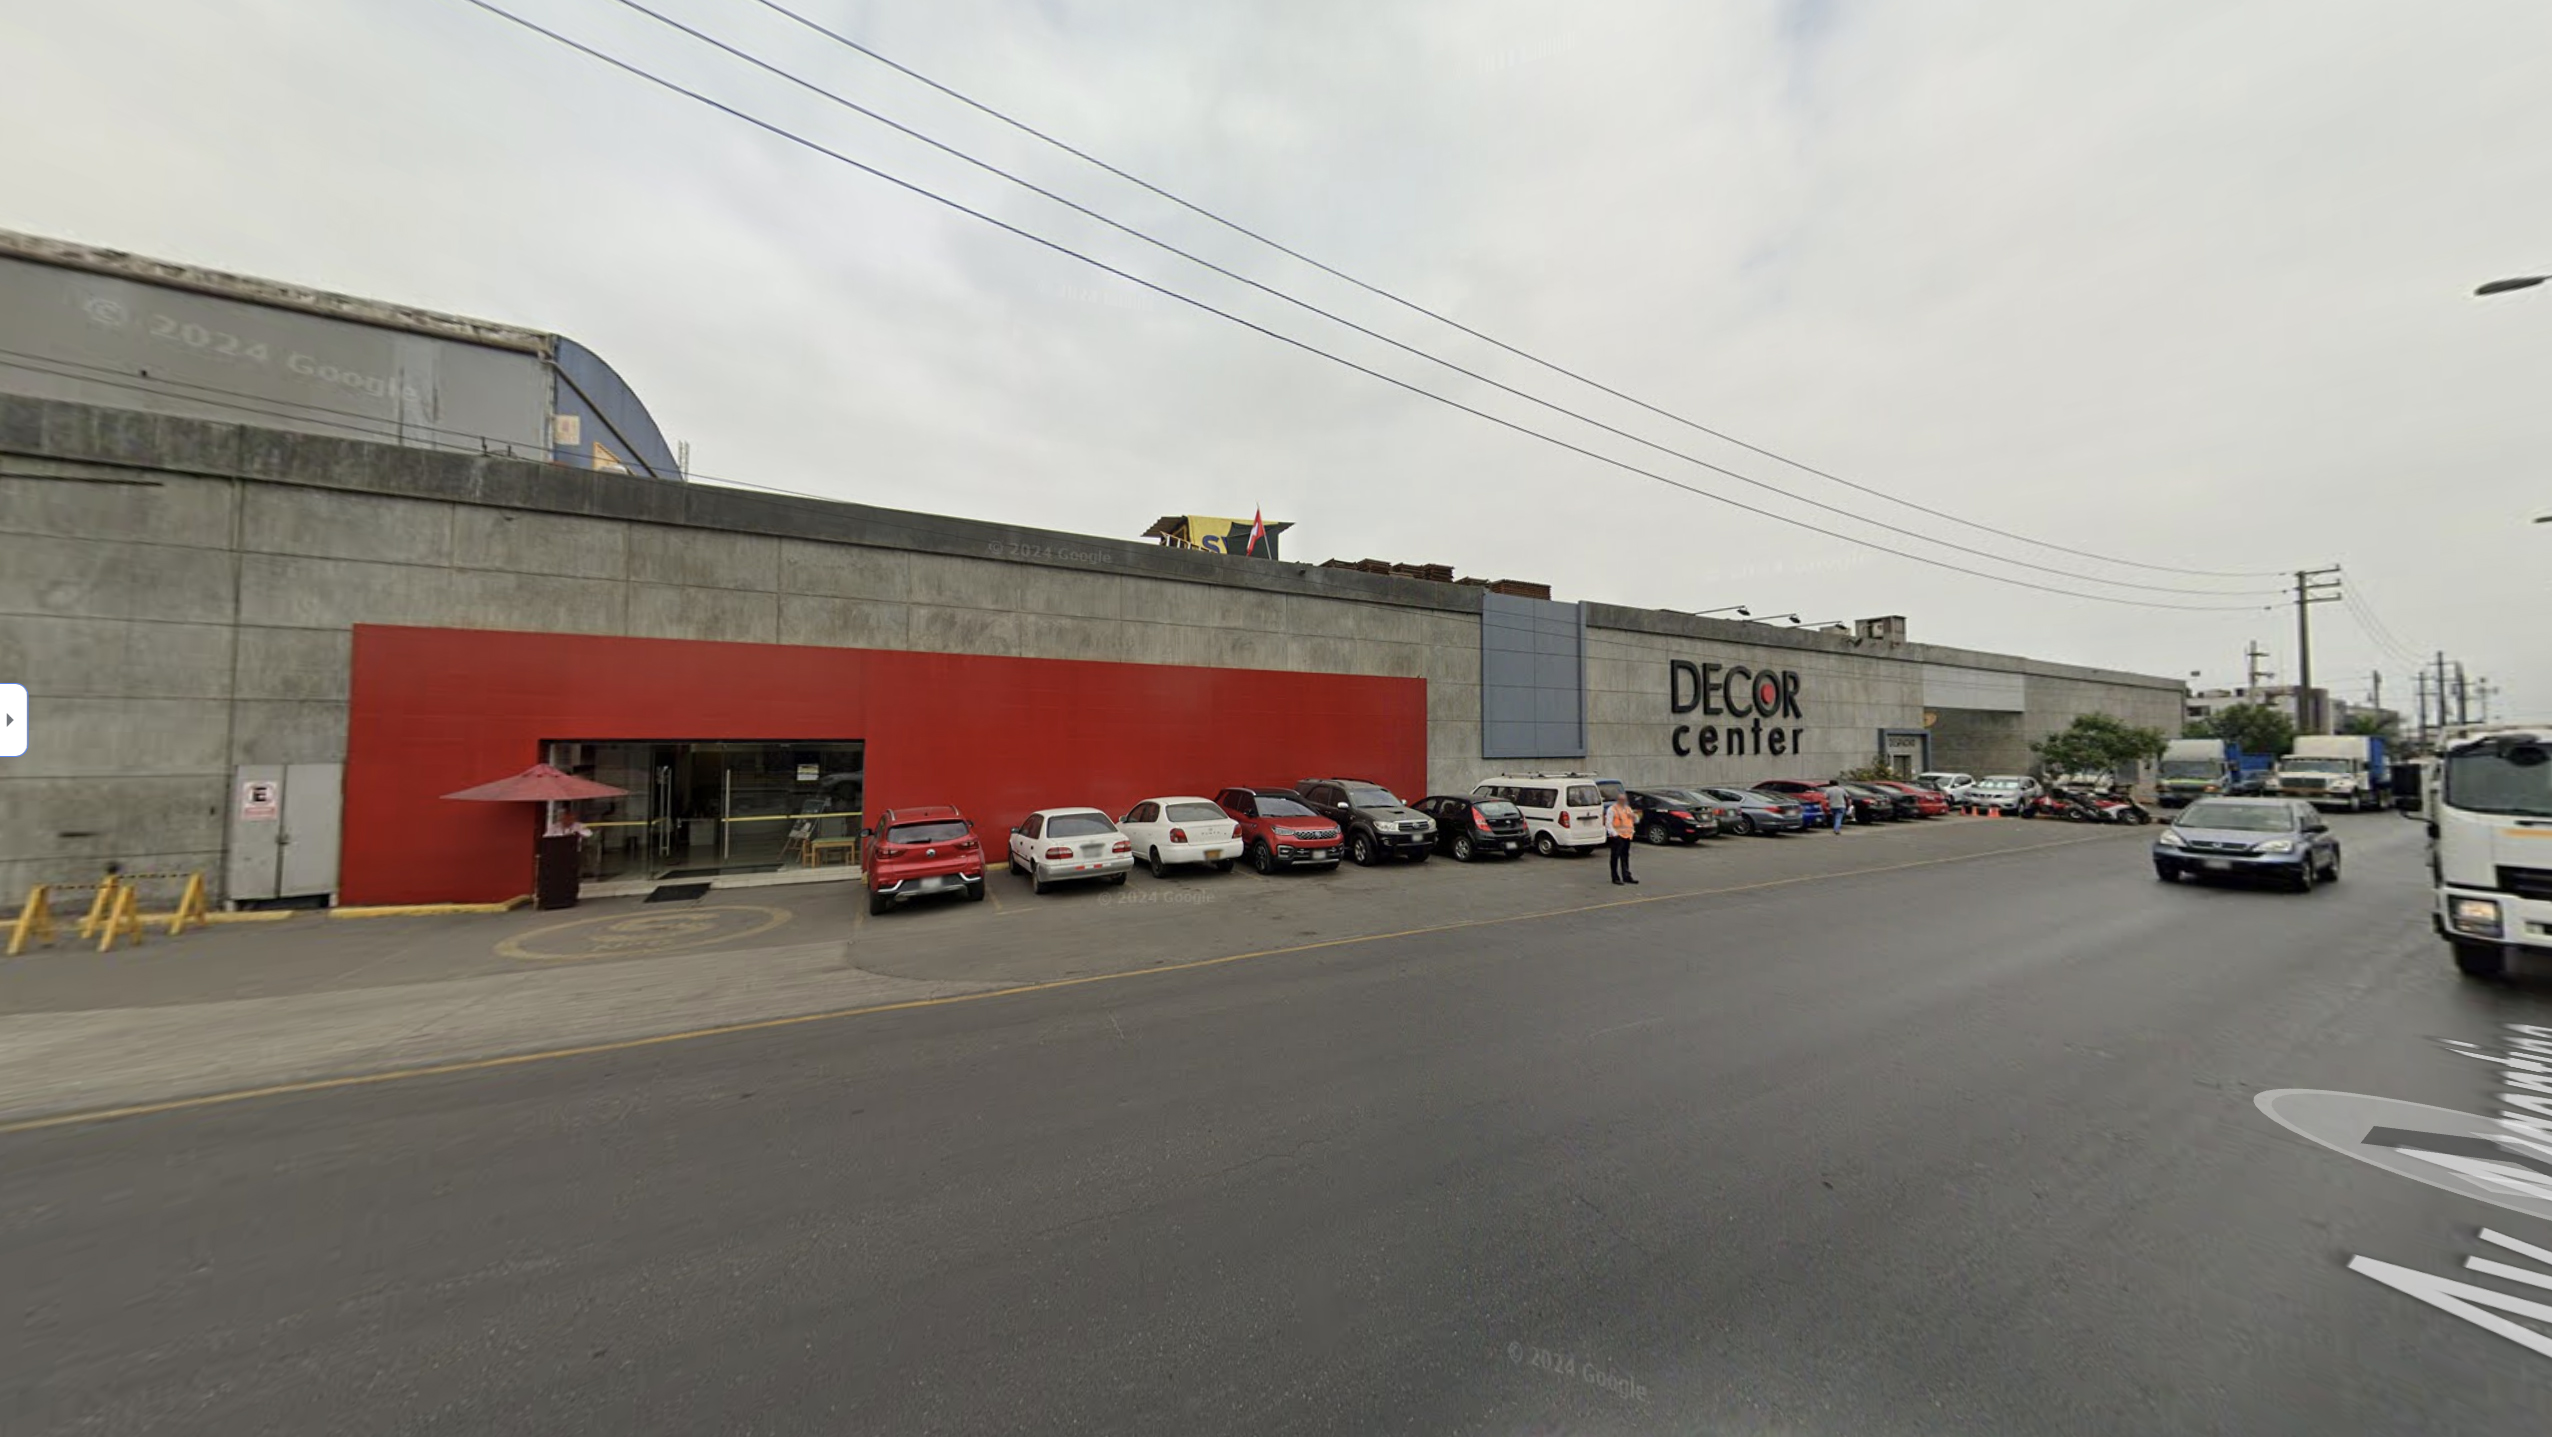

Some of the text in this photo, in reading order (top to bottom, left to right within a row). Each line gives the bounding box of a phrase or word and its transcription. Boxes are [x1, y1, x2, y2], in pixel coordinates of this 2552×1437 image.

[1670, 659, 1803, 719] DECOR
[1672, 718, 1804, 757] center
[253, 786, 267, 802] E
